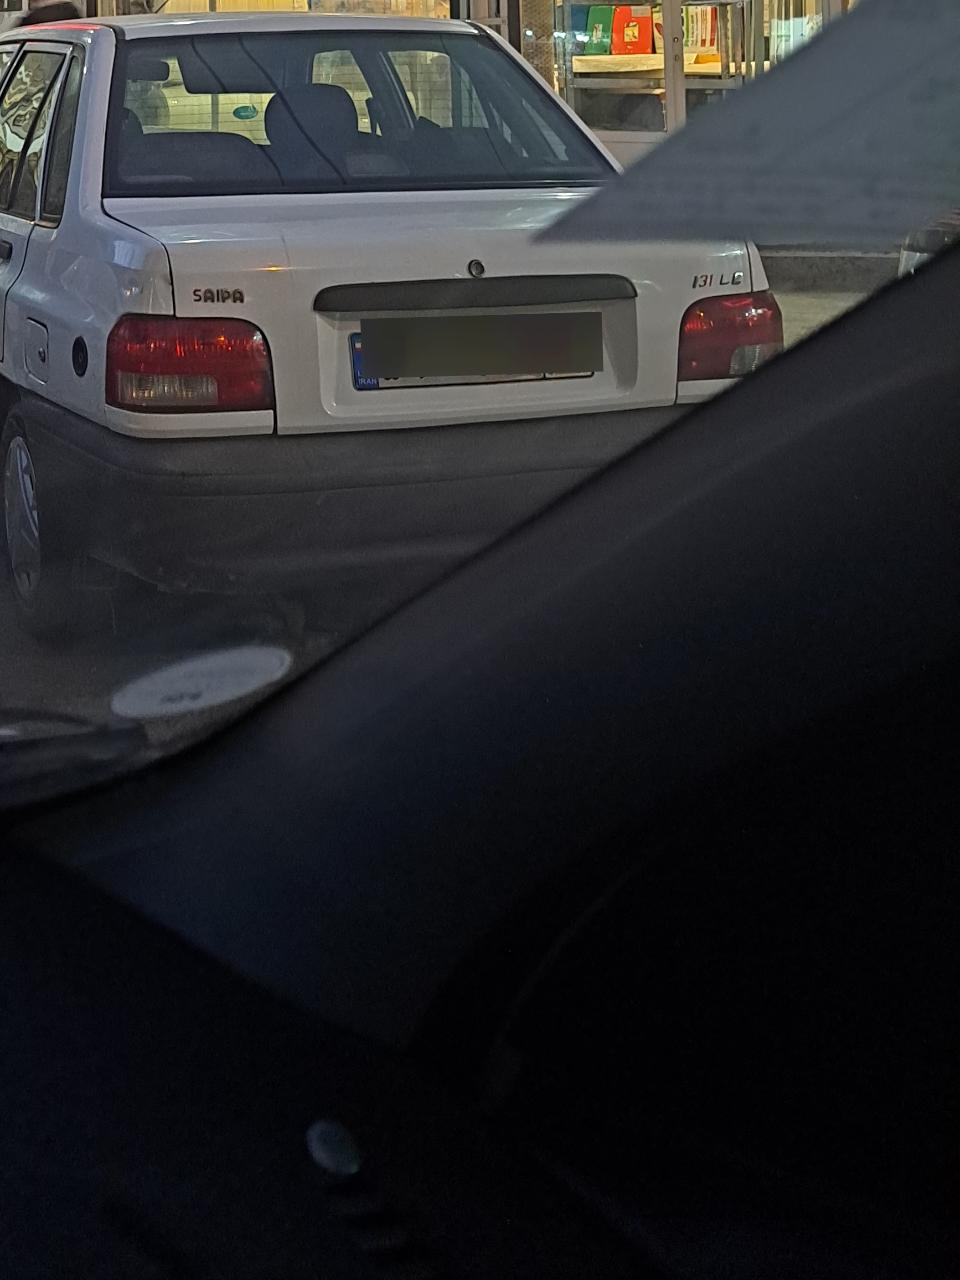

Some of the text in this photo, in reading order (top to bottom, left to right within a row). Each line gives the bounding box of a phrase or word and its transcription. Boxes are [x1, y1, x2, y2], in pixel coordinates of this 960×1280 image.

[691, 273, 714, 289] 131
[192, 287, 245, 304] SAIPA
[358, 378, 377, 386] IRAN
